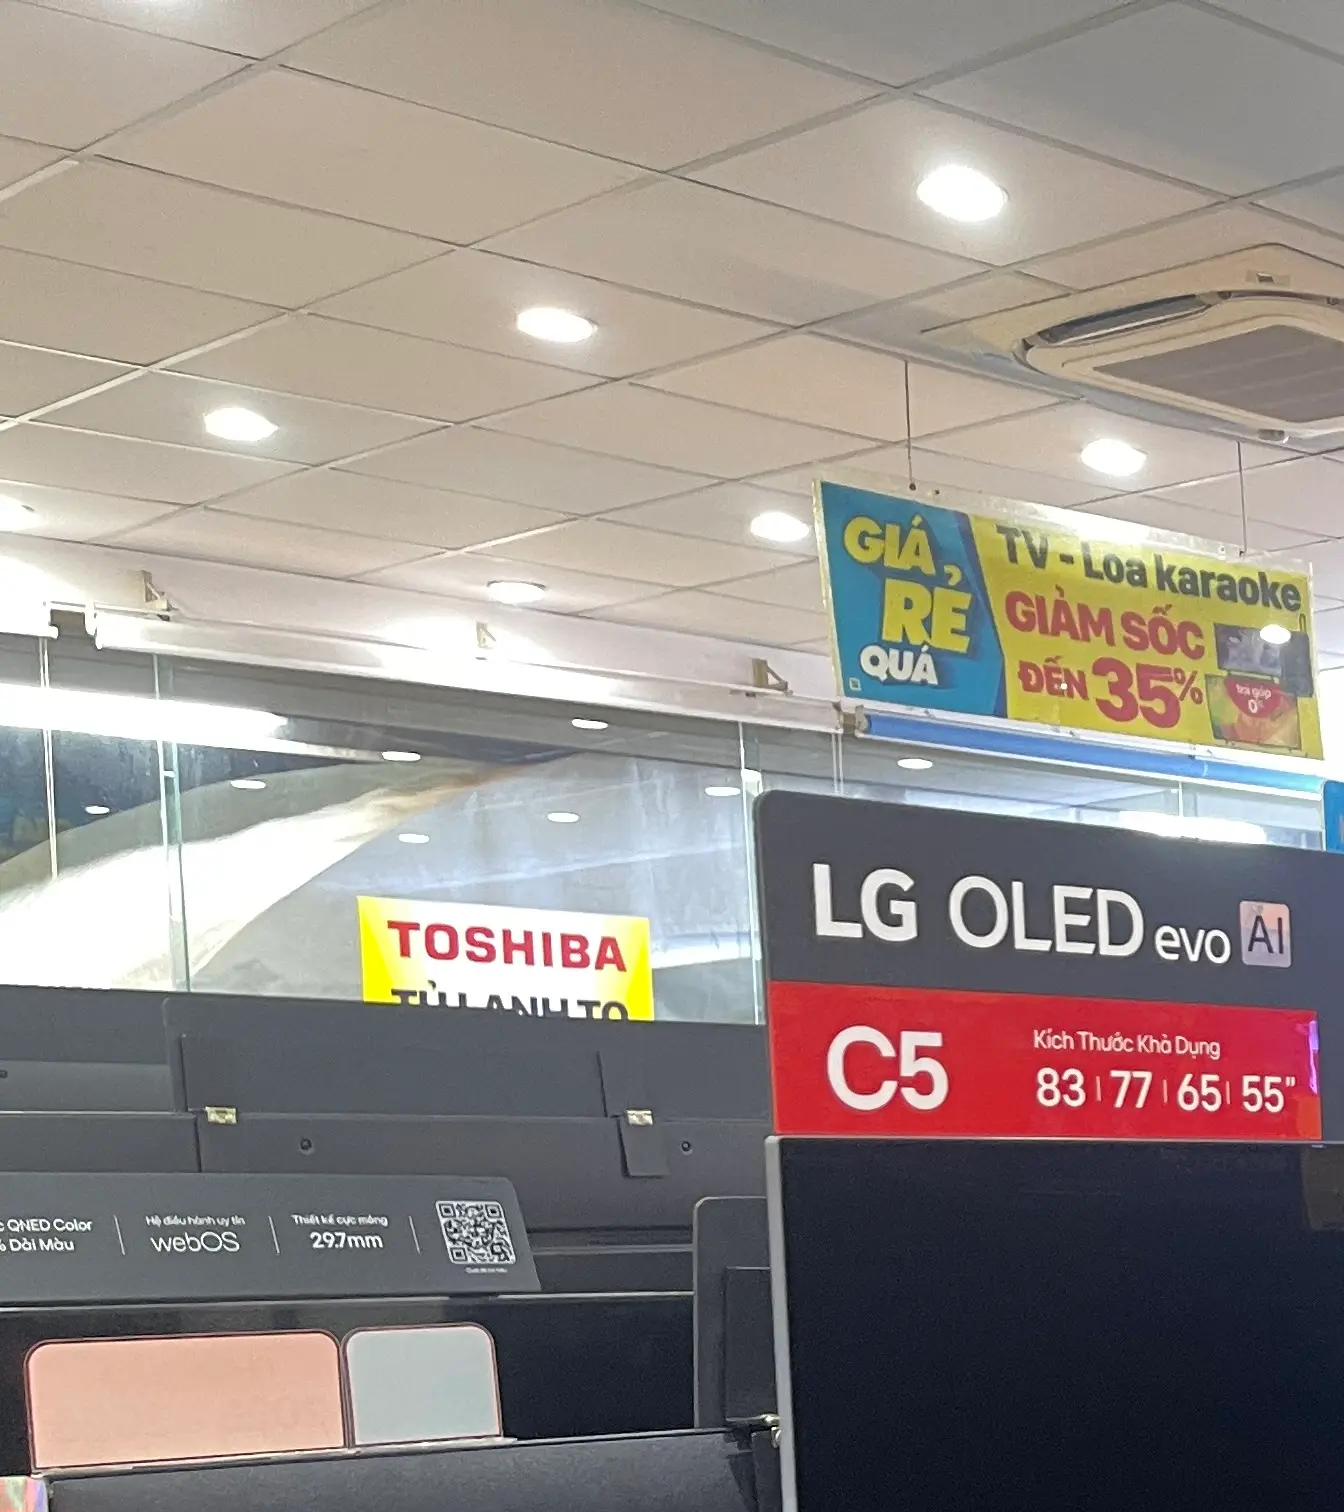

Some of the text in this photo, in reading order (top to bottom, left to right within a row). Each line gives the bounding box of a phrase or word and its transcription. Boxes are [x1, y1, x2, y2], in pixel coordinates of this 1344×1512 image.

[842, 514, 934, 577] GIÁ
[996, 523, 1048, 570] TV
[1083, 541, 1148, 589] Loa
[1153, 552, 1302, 613] karaoke
[880, 566, 973, 655] RẺ
[1005, 585, 1206, 660] GIẢM SỐC
[859, 643, 938, 686] QUÁ
[1018, 655, 1204, 730] ĐẾN 35%
[813, 862, 1286, 965] LG OLED evo AI
[387, 920, 627, 972] TOSHIBA
[826, 1024, 950, 1112] C5
[1033, 1028, 1221, 1061] Kích Thước Khả Dụng
[1036, 1067, 1296, 1113] 83 77 65 55"
[7, 1218, 93, 1233] QNED Color
[9, 1235, 75, 1251] Dải Màu
[146, 1215, 161, 1228] Hệ
[187, 1215, 215, 1226] hành
[151, 1231, 241, 1252] webOS
[310, 1231, 384, 1249] 29.7mm
